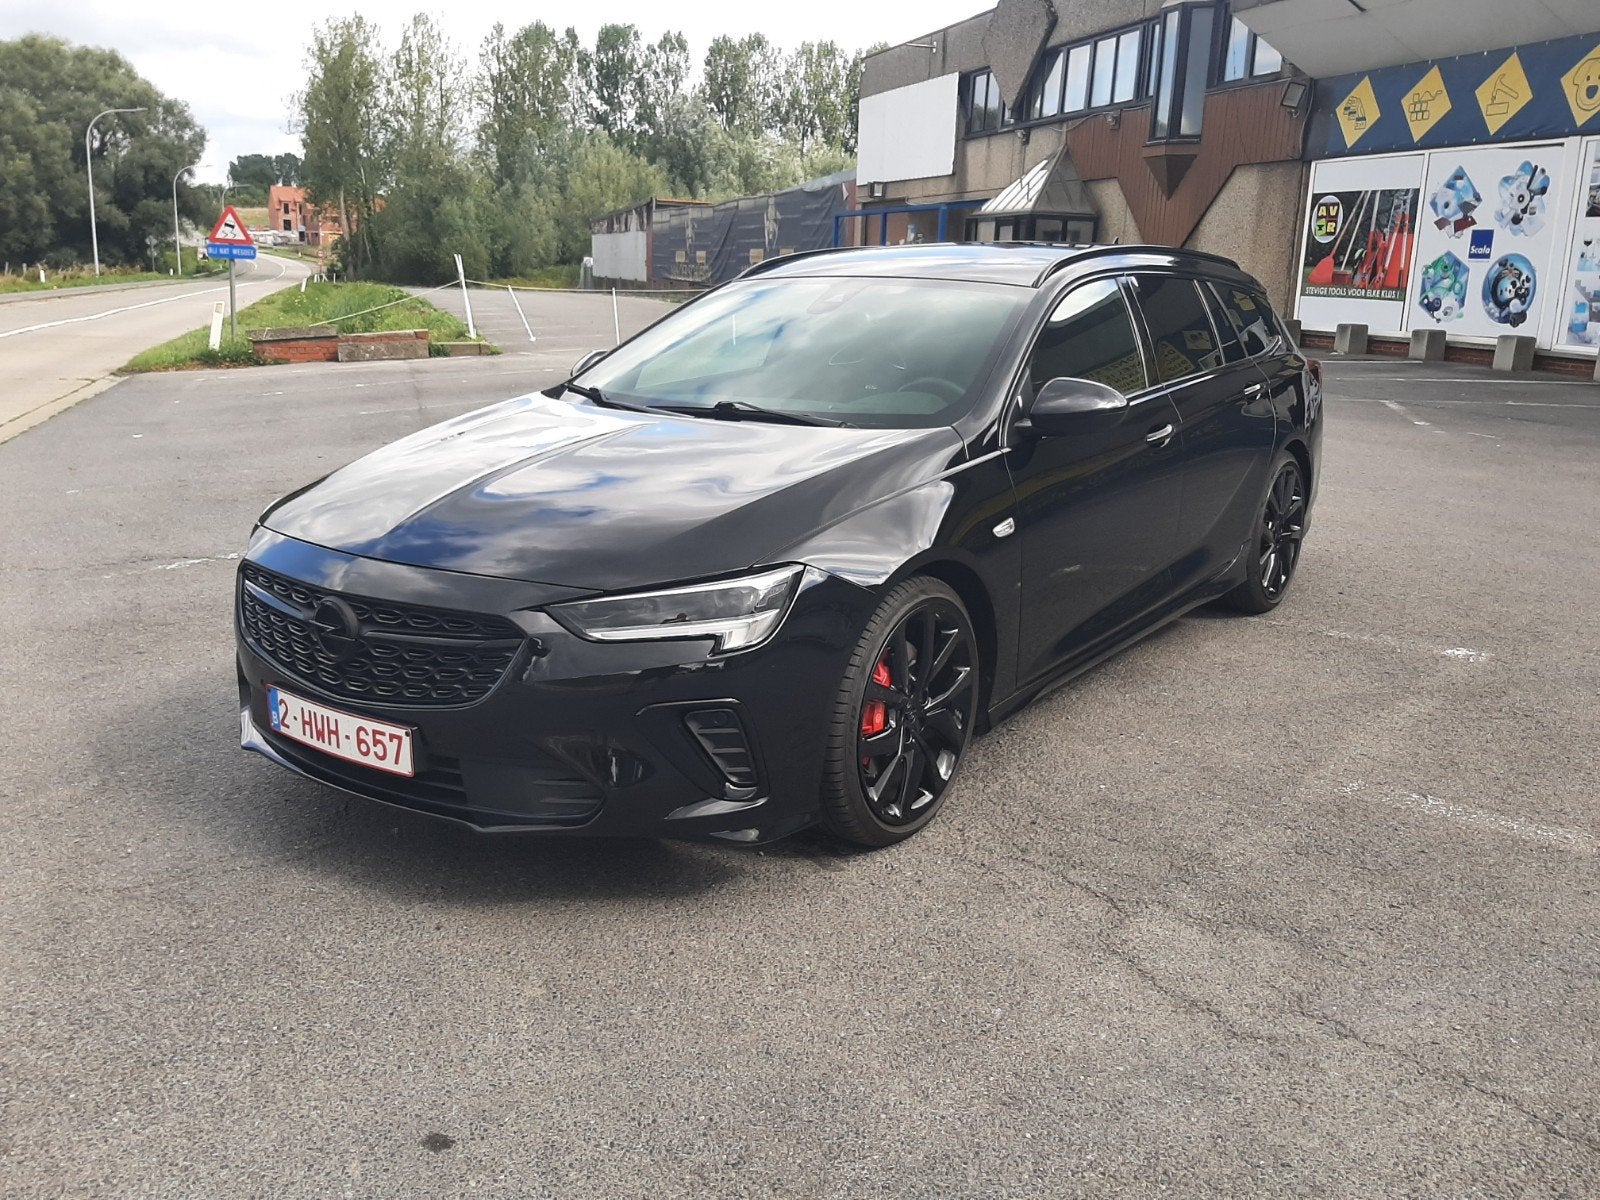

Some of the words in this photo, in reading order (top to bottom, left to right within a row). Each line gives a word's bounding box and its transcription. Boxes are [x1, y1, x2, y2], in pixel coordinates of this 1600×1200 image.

[1470, 245, 1490, 254] Scala
[1305, 286, 1328, 295] STEVIGE
[1328, 287, 1347, 296] TOOLS
[1348, 288, 1366, 297] VOOR
[1366, 289, 1380, 297] ELKE
[1380, 290, 1396, 298] KLUS
[272, 711, 278, 724] B
[279, 698, 404, 766] 2-HWH-657
